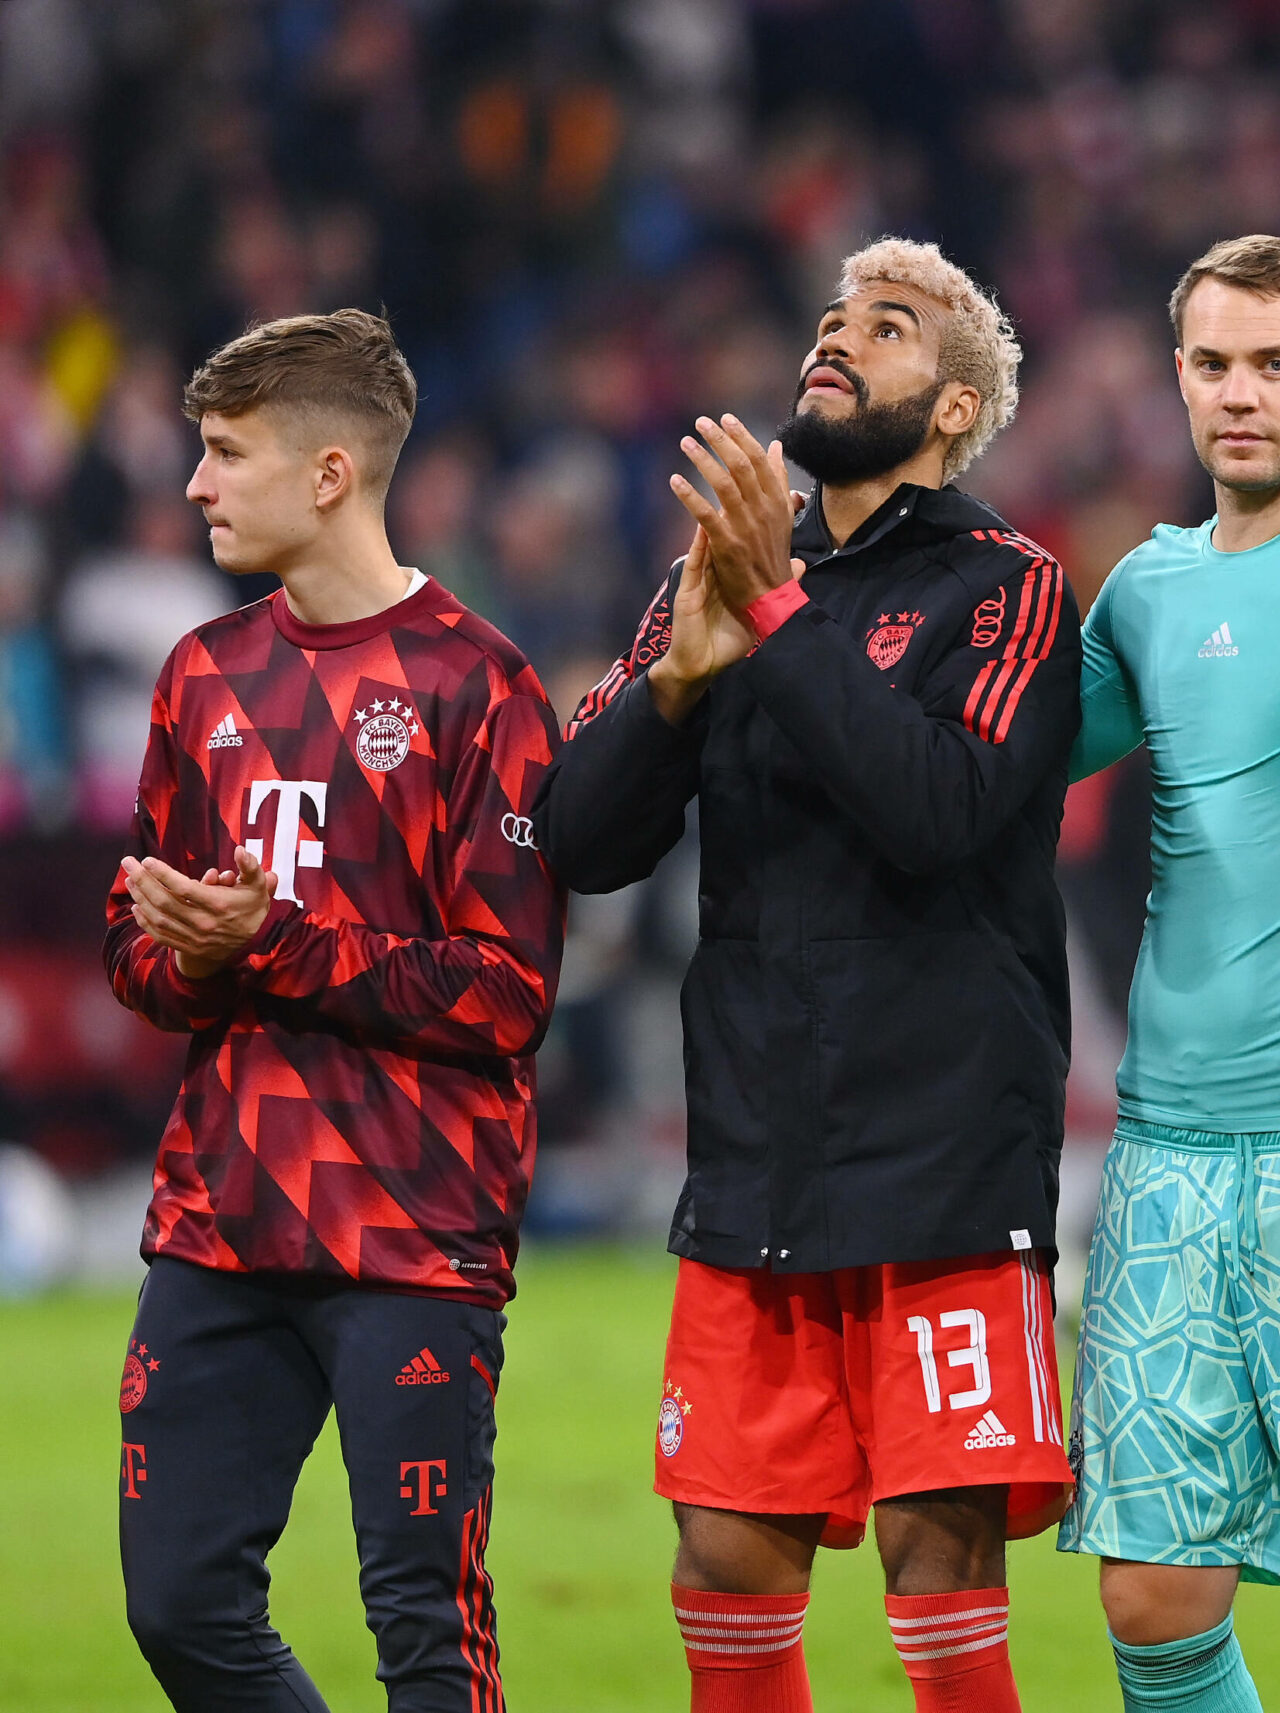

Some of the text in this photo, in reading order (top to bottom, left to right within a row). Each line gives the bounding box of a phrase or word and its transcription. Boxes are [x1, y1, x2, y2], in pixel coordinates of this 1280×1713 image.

[1197, 644, 1239, 658] adidas
[207, 734, 243, 749] adidas
[365, 718, 406, 744] FC BAYERN
[247, 779, 328, 909] T
[906, 1308, 992, 1414] 13
[395, 1370, 450, 1386] adidas
[963, 1433, 1017, 1450] adidas
[400, 1459, 447, 1516] T
